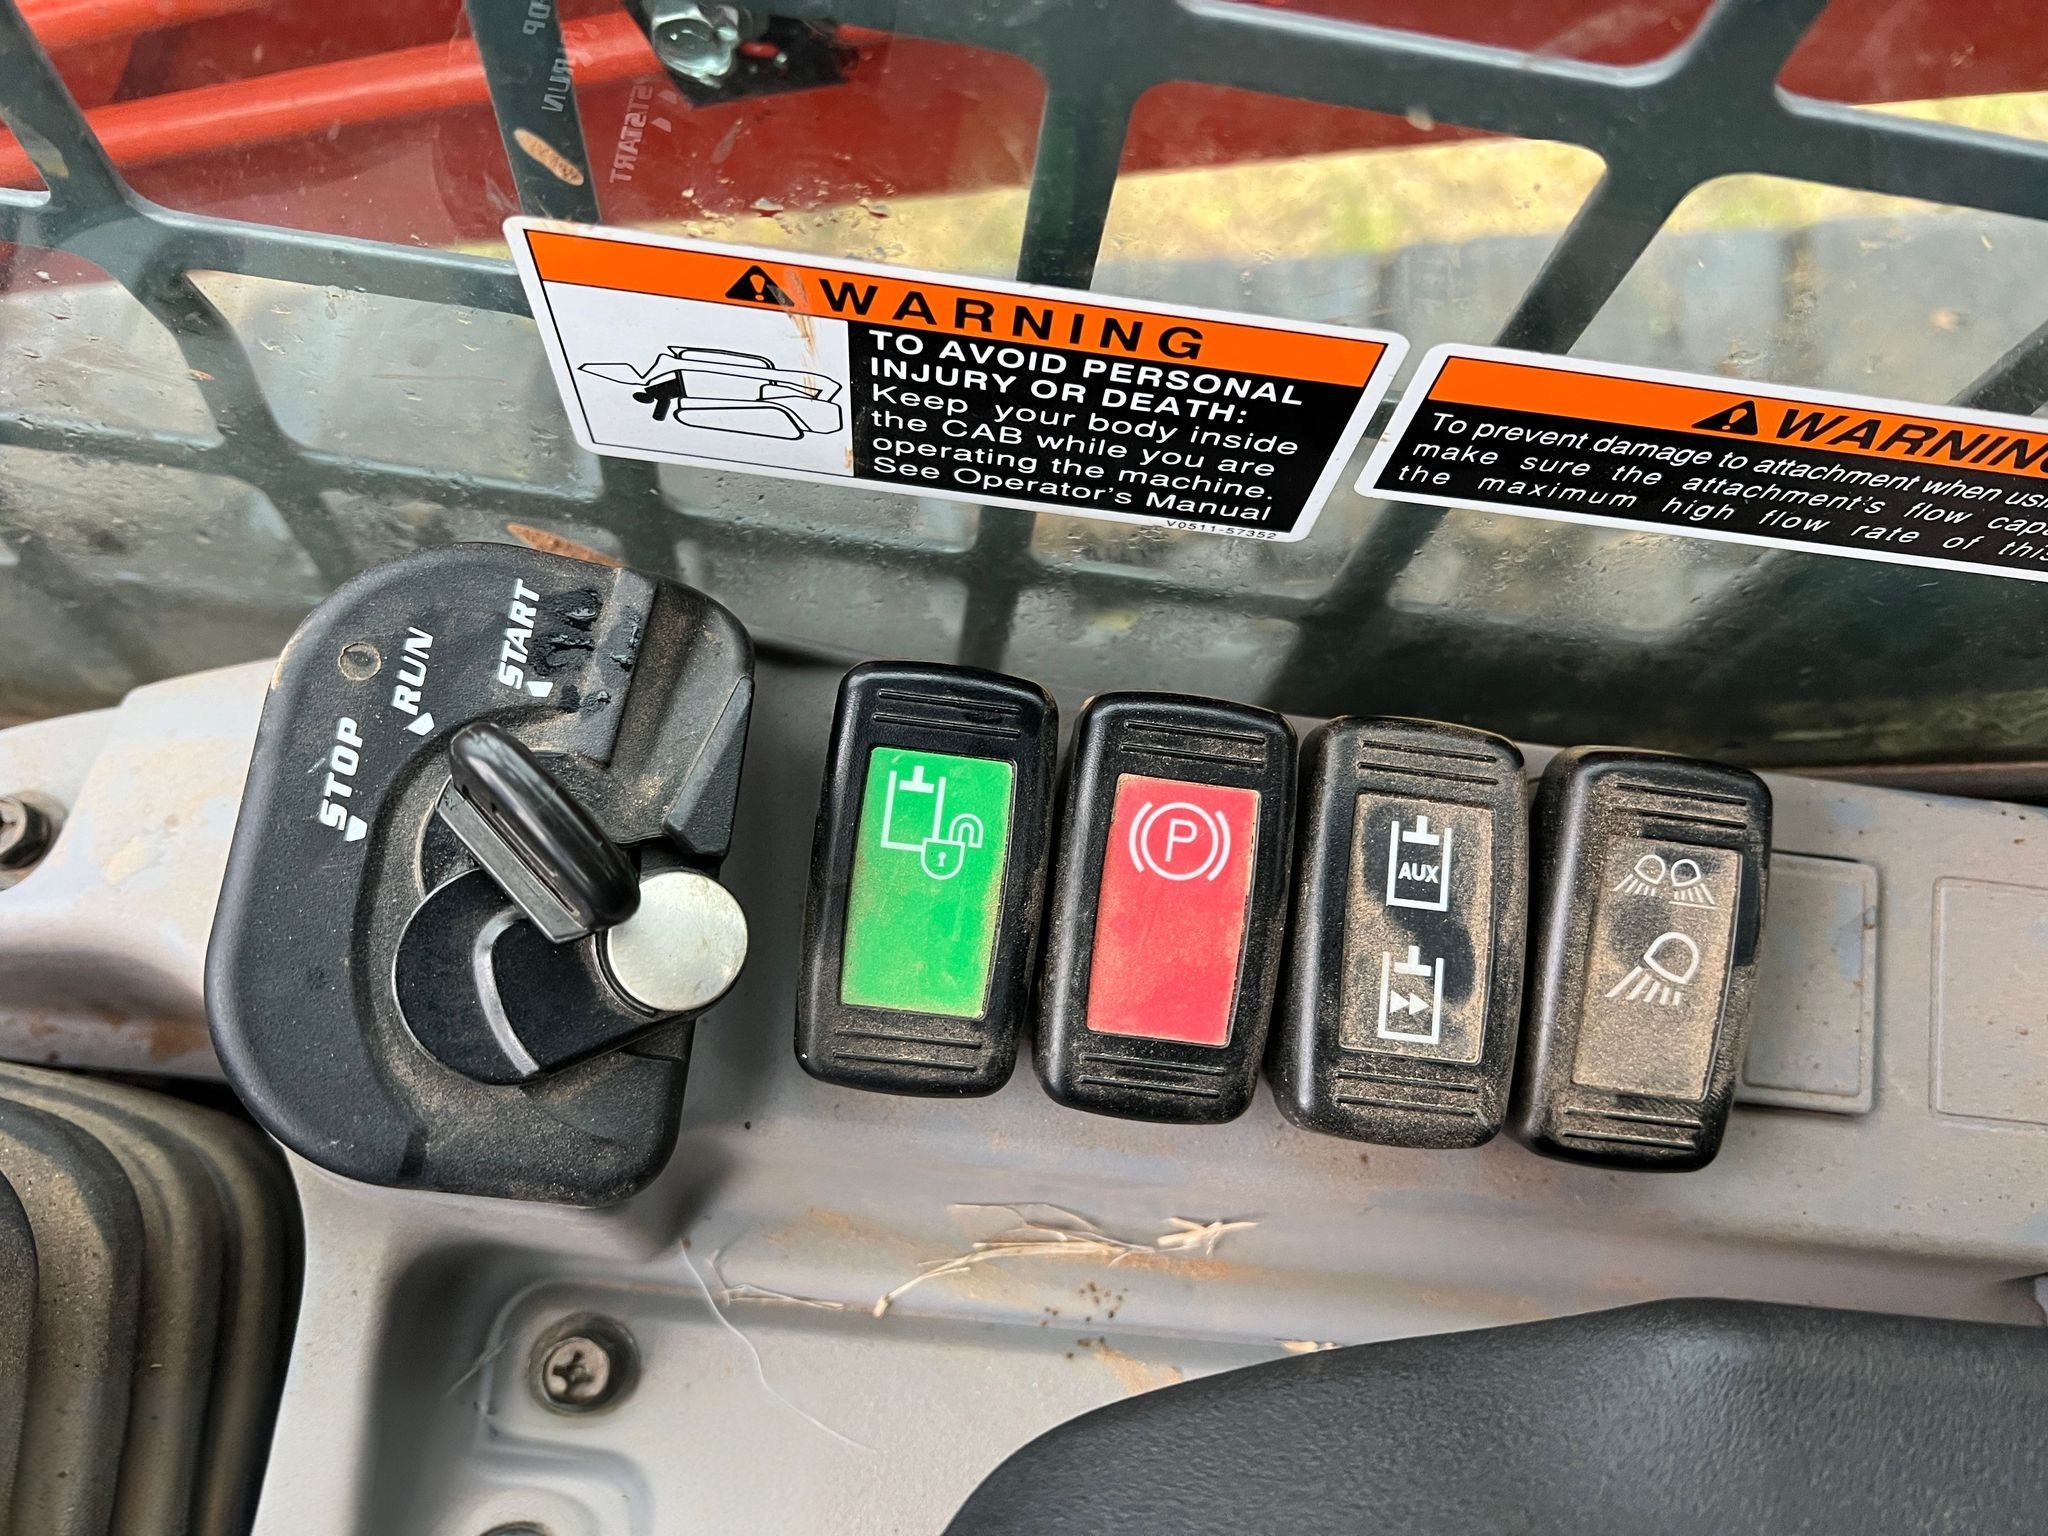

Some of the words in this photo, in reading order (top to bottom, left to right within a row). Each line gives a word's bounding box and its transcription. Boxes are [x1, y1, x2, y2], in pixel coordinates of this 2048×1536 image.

[818, 278, 1205, 361] WARNING
[868, 328, 925, 358] TO
[938, 338, 1068, 376] AVOID
[1081, 357, 1304, 407] PERSONAL
[870, 356, 1017, 394] INJURY
[1030, 378, 1088, 405] OR
[1100, 387, 1248, 425] DEATH:
[871, 408, 929, 433] the
[941, 419, 1024, 446] CAB
[1036, 428, 1130, 460] while
[1140, 445, 1204, 472] you
[1217, 455, 1277, 477] are
[872, 383, 969, 415] Keep
[994, 402, 1078, 430] your
[1088, 411, 1180, 445] body
[1190, 423, 1300, 457] inside
[1431, 411, 1468, 435] To
[1471, 420, 1590, 451] prevent
[1592, 434, 1714, 468] damage
[1718, 452, 1748, 470] to
[1753, 456, 1922, 492] attachment
[1921, 478, 2004, 503] when
[872, 437, 1038, 476] operating
[1051, 455, 1105, 480] the
[1117, 466, 1275, 502] machine.
[873, 454, 941, 481] See
[953, 466, 1133, 506] Operator's
[1145, 491, 1273, 523] Manual
[1397, 464, 1452, 486] the
[1476, 476, 1639, 509] maximum
[1660, 496, 1736, 523] high
[1758, 508, 1833, 534] flow
[1850, 522, 1922, 546] rate
[1942, 534, 1986, 551] of
[1411, 441, 1500, 467] make
[1519, 455, 1592, 478] sure
[1611, 464, 1663, 486] the
[1682, 475, 1887, 515] attachment's
[1903, 502, 1974, 526] flow
[1166, 518, 1279, 541] V0511-57352
[391, 626, 434, 716] RUN
[498, 577, 540, 690] START
[319, 716, 364, 831] STOP
[1164, 817, 1198, 863] P
[1397, 860, 1440, 885] AUX
